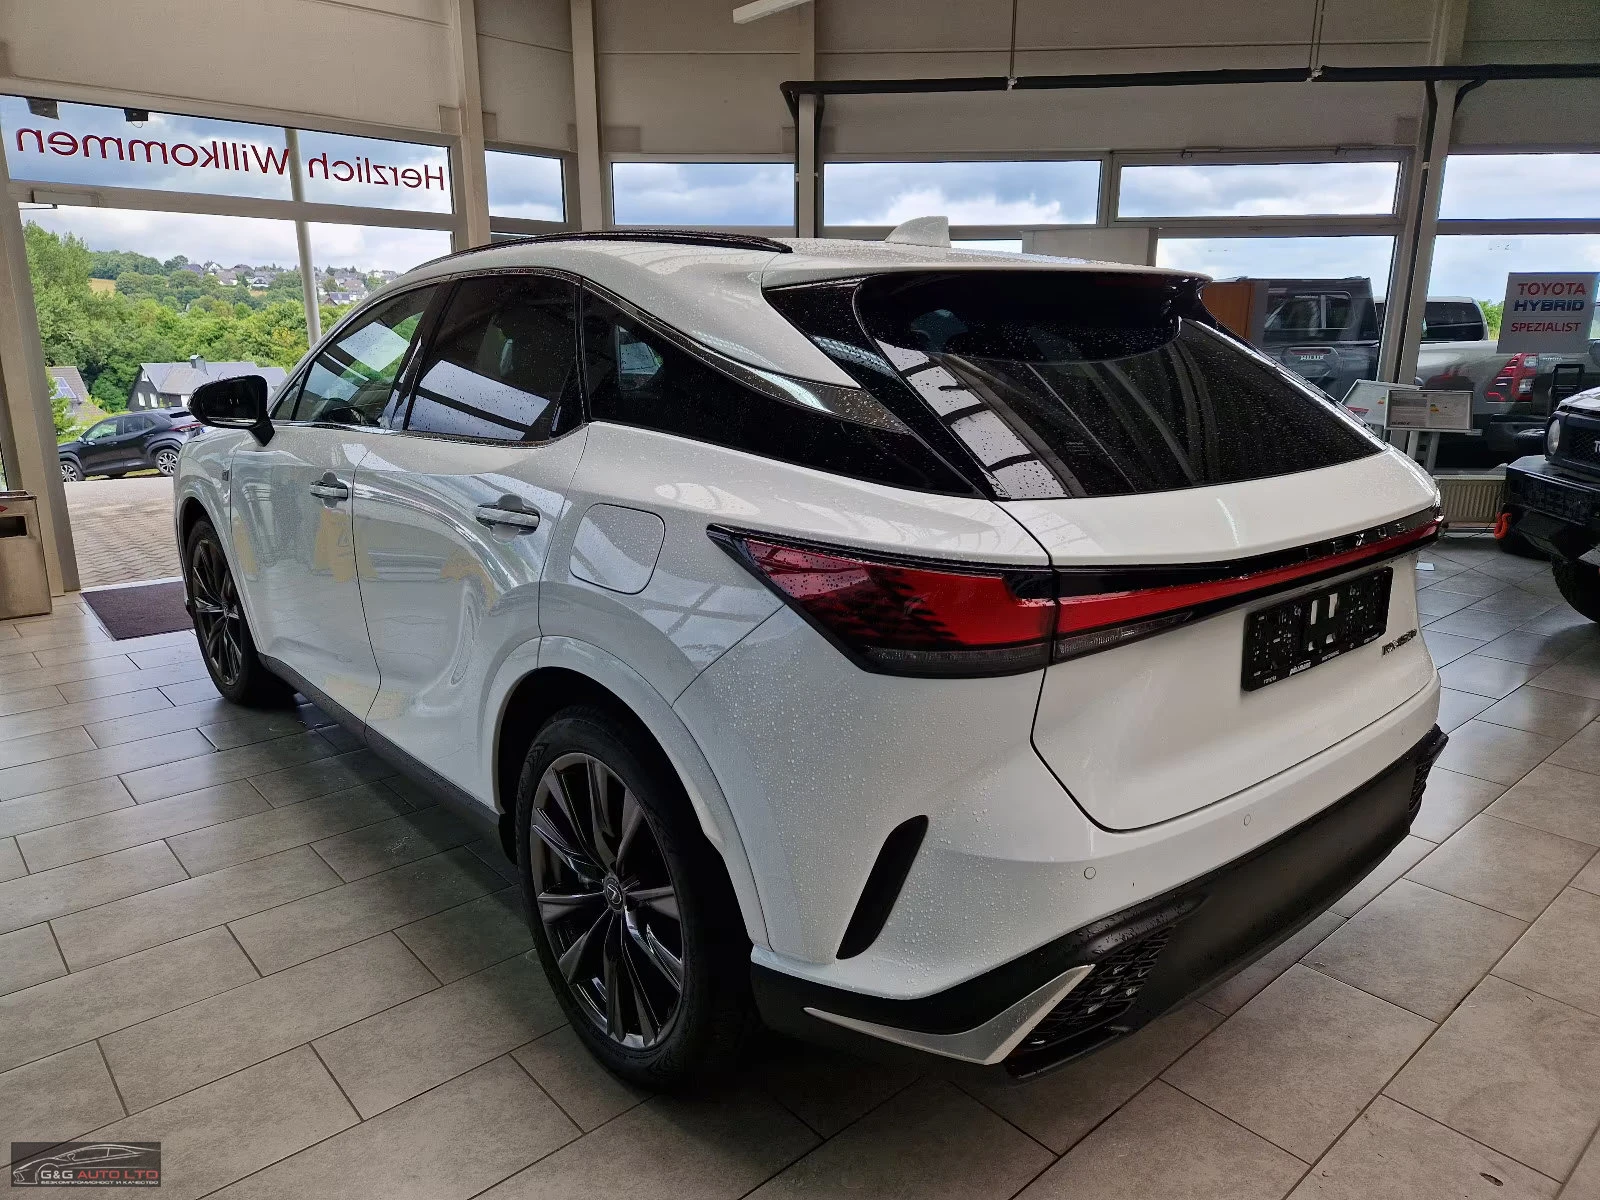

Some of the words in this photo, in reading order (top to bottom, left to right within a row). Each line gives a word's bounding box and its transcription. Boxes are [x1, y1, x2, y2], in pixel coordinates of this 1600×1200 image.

[1517, 282, 1587, 296] TOYOTA
[1513, 299, 1585, 312] HYBRID
[1511, 322, 1582, 333] SPEZIALIST
[1304, 521, 1406, 560] LEXUS
